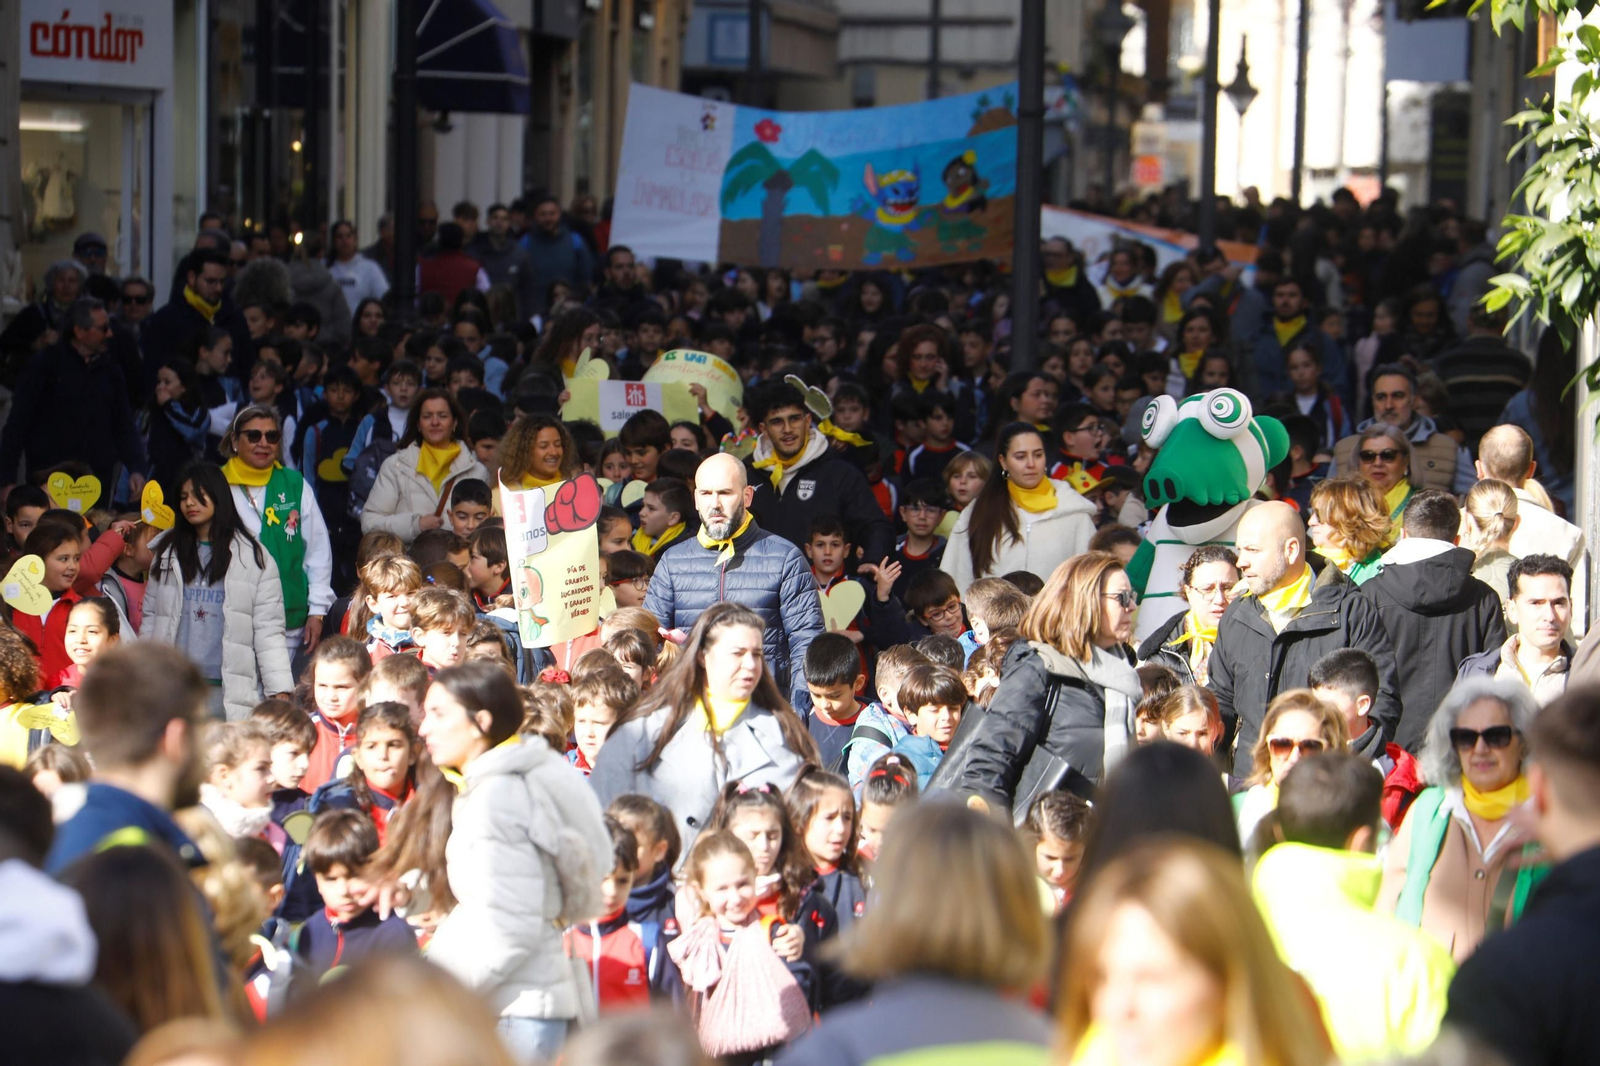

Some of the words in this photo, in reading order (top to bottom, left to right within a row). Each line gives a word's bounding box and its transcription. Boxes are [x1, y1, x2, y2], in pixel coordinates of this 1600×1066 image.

[30, 8, 144, 64] cóndor
[565, 575, 590, 586] GRANDES
[183, 587, 225, 603] APPINE
[560, 584, 594, 599] LUCHADORES
[563, 601, 568, 610] Y
[569, 596, 592, 608] GRANDES
